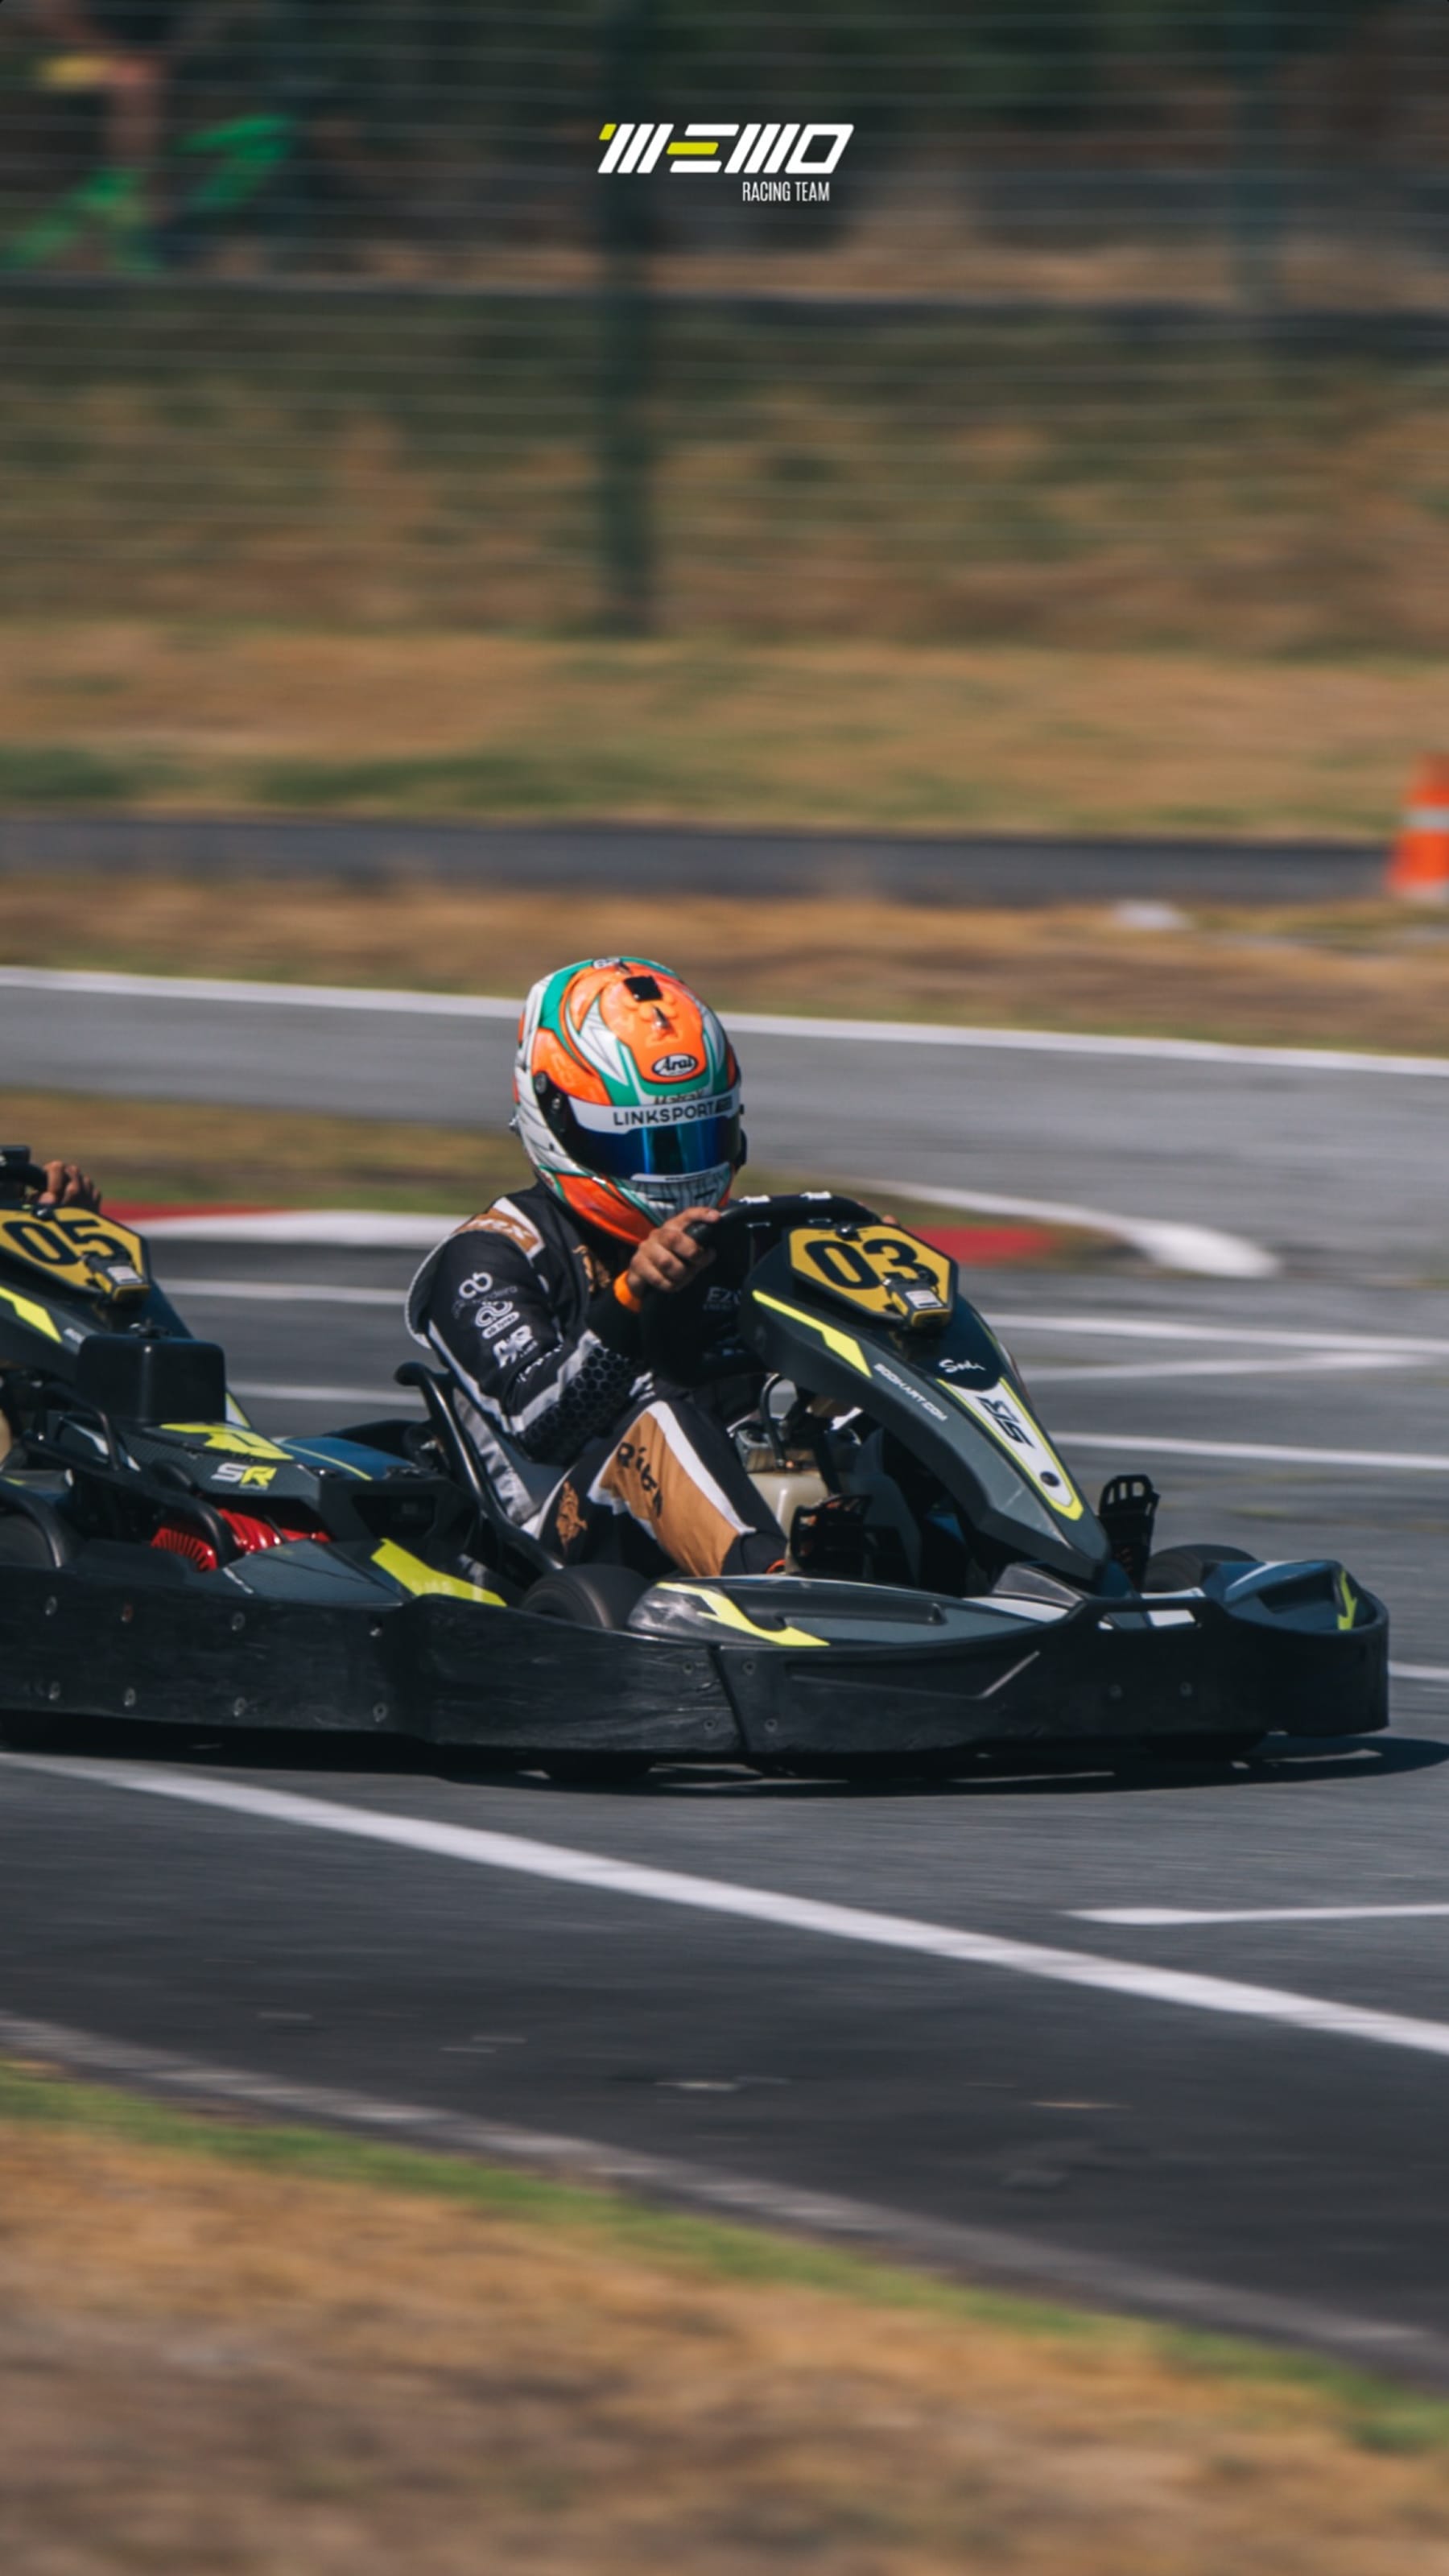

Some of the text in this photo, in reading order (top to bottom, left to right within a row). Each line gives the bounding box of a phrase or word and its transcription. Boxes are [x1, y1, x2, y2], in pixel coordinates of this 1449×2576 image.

[660, 1055, 694, 1071] Arai
[613, 1102, 715, 1125] LINKSPORT
[2, 1220, 133, 1266] 05
[805, 1238, 939, 1290] 03
[210, 1462, 277, 1488] SR
